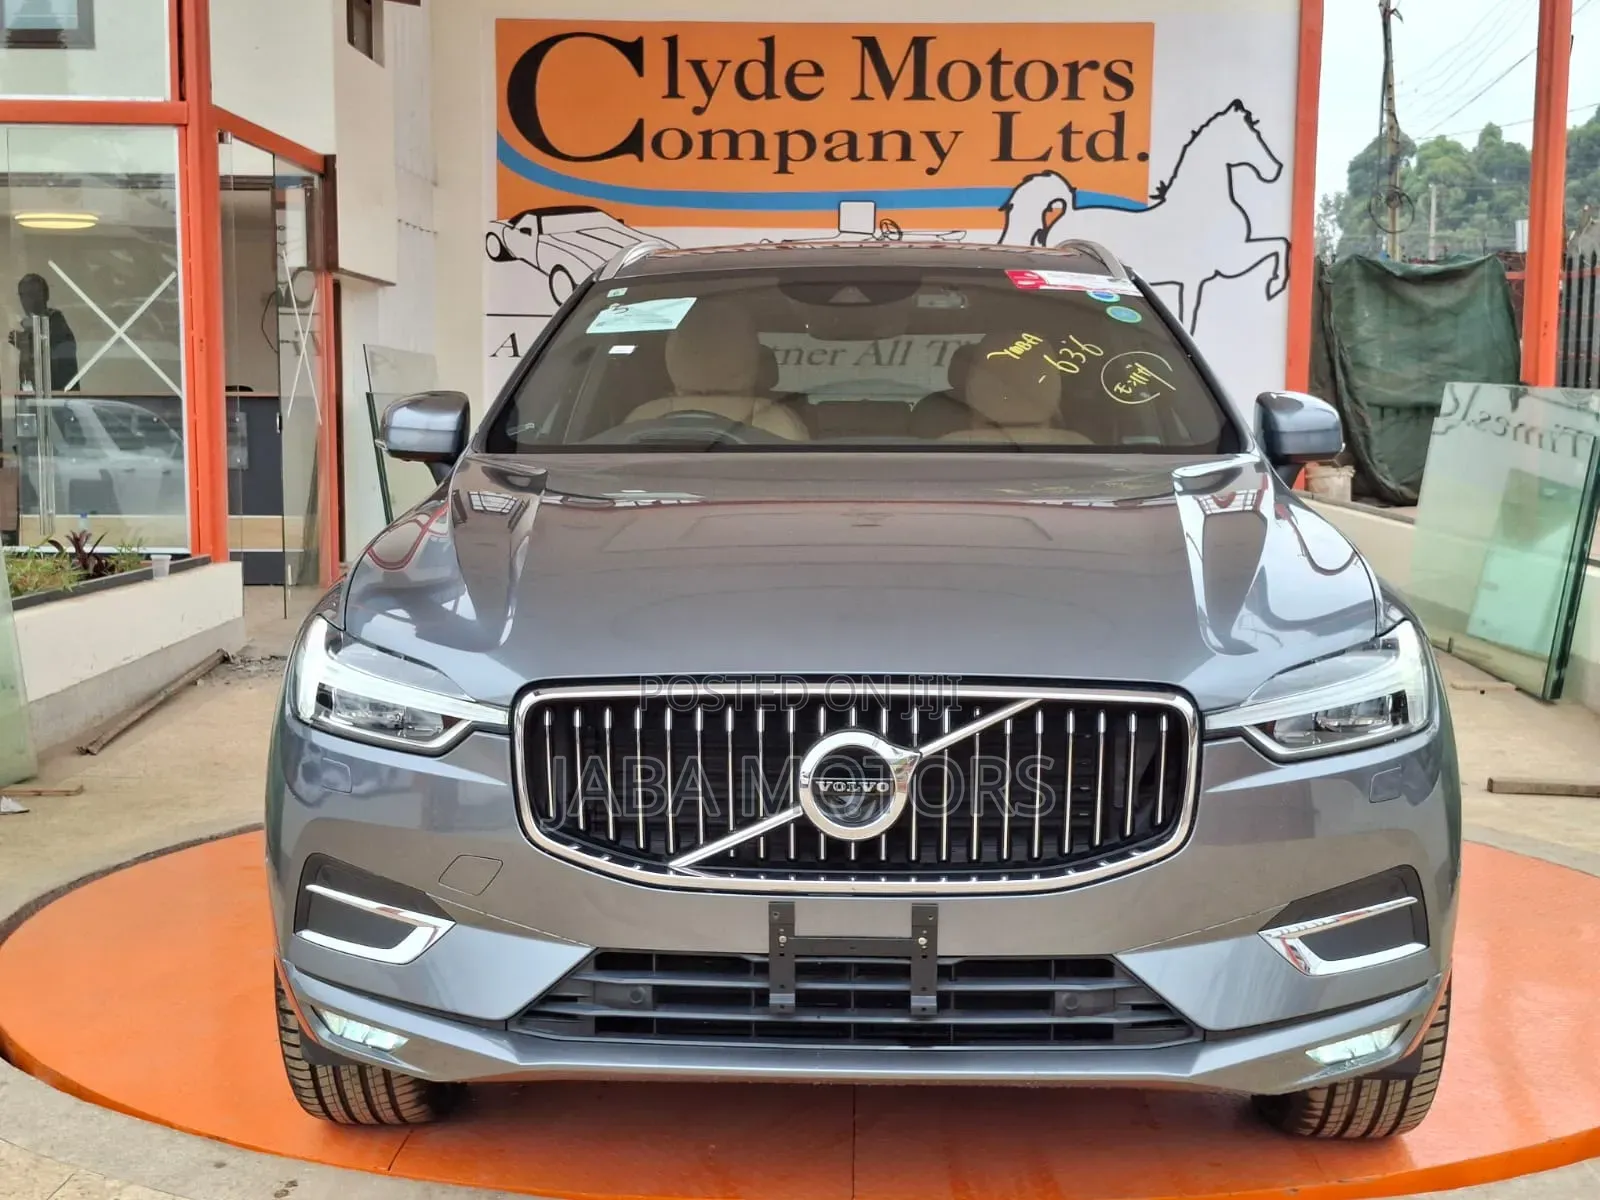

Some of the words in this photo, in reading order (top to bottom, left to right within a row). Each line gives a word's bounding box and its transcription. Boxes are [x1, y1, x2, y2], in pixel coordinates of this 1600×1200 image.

[507, 32, 825, 162] Clyde
[852, 36, 1134, 102] Motors
[990, 111, 1149, 162] Ltd.
[489, 332, 522, 358] A
[852, 339, 914, 366] All
[815, 781, 890, 793] VOLVO
